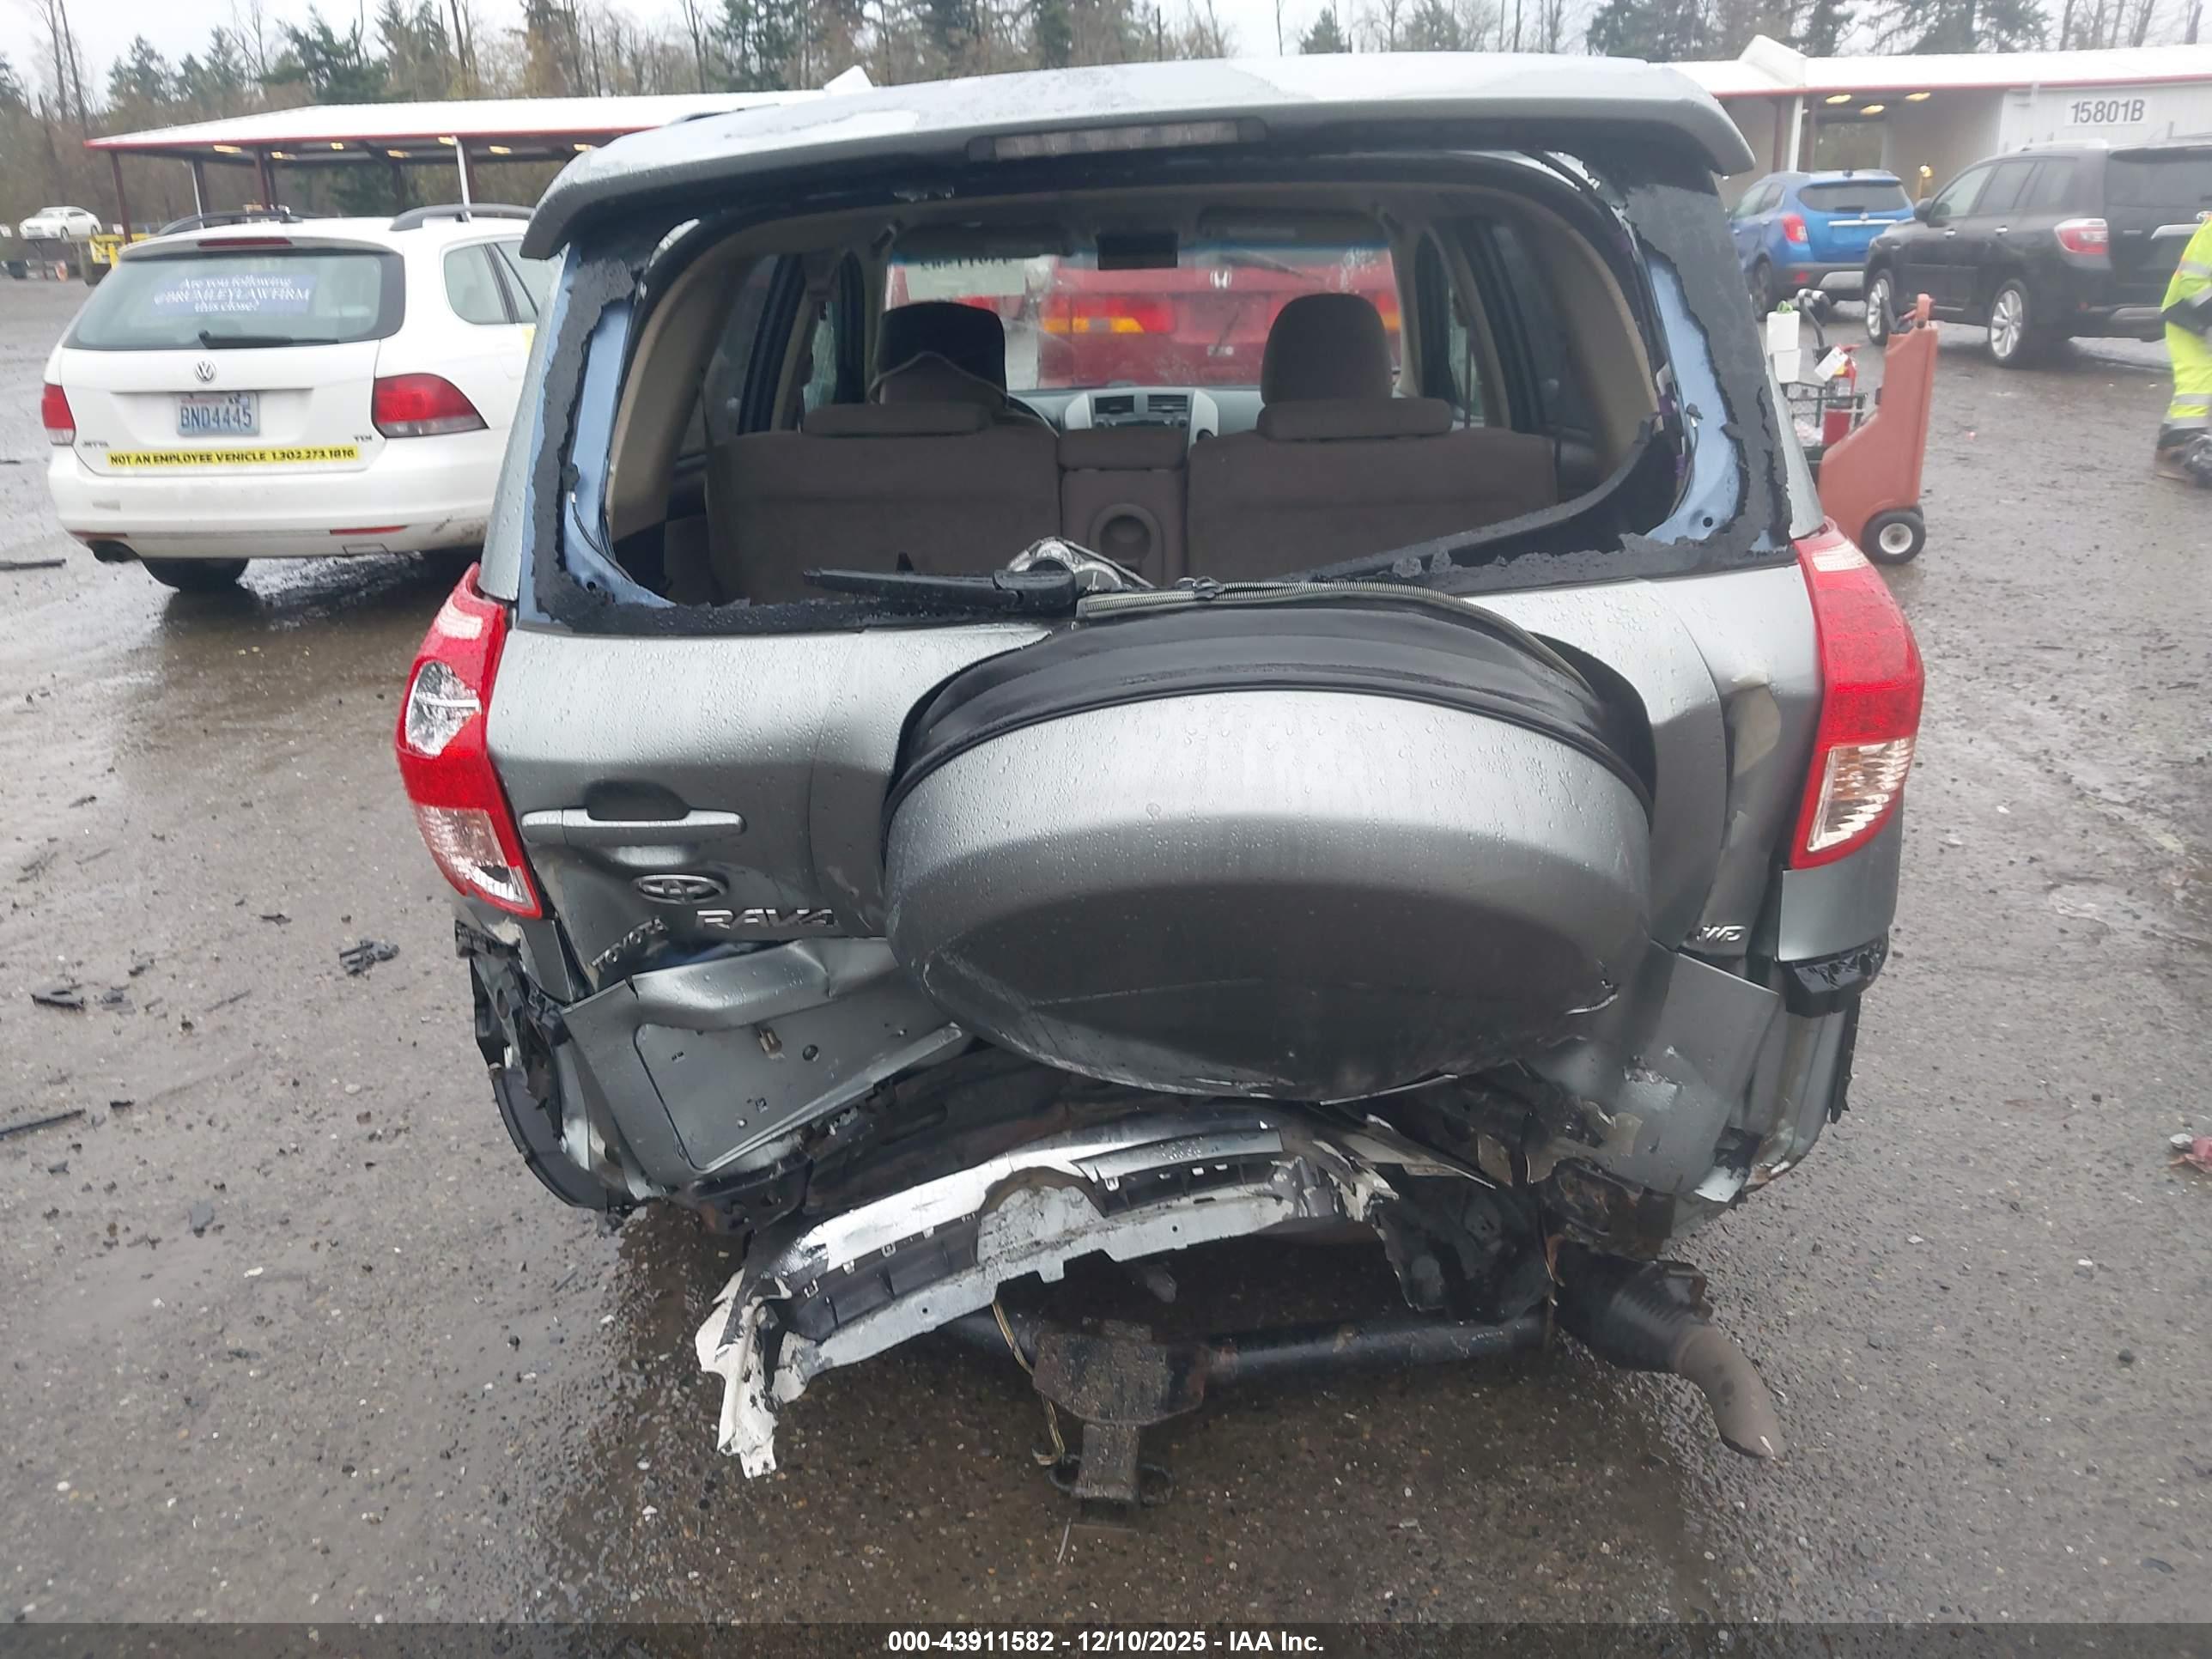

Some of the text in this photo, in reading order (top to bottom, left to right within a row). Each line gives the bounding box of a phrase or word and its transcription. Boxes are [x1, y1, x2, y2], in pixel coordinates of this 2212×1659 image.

[2070, 99, 2145, 124] 15801B
[110, 454, 131, 465] NOT
[135, 454, 151, 465] AN
[153, 453, 213, 465] EMPLOYEE
[216, 452, 266, 463] VEHICLE
[696, 908, 836, 929] RAV4
